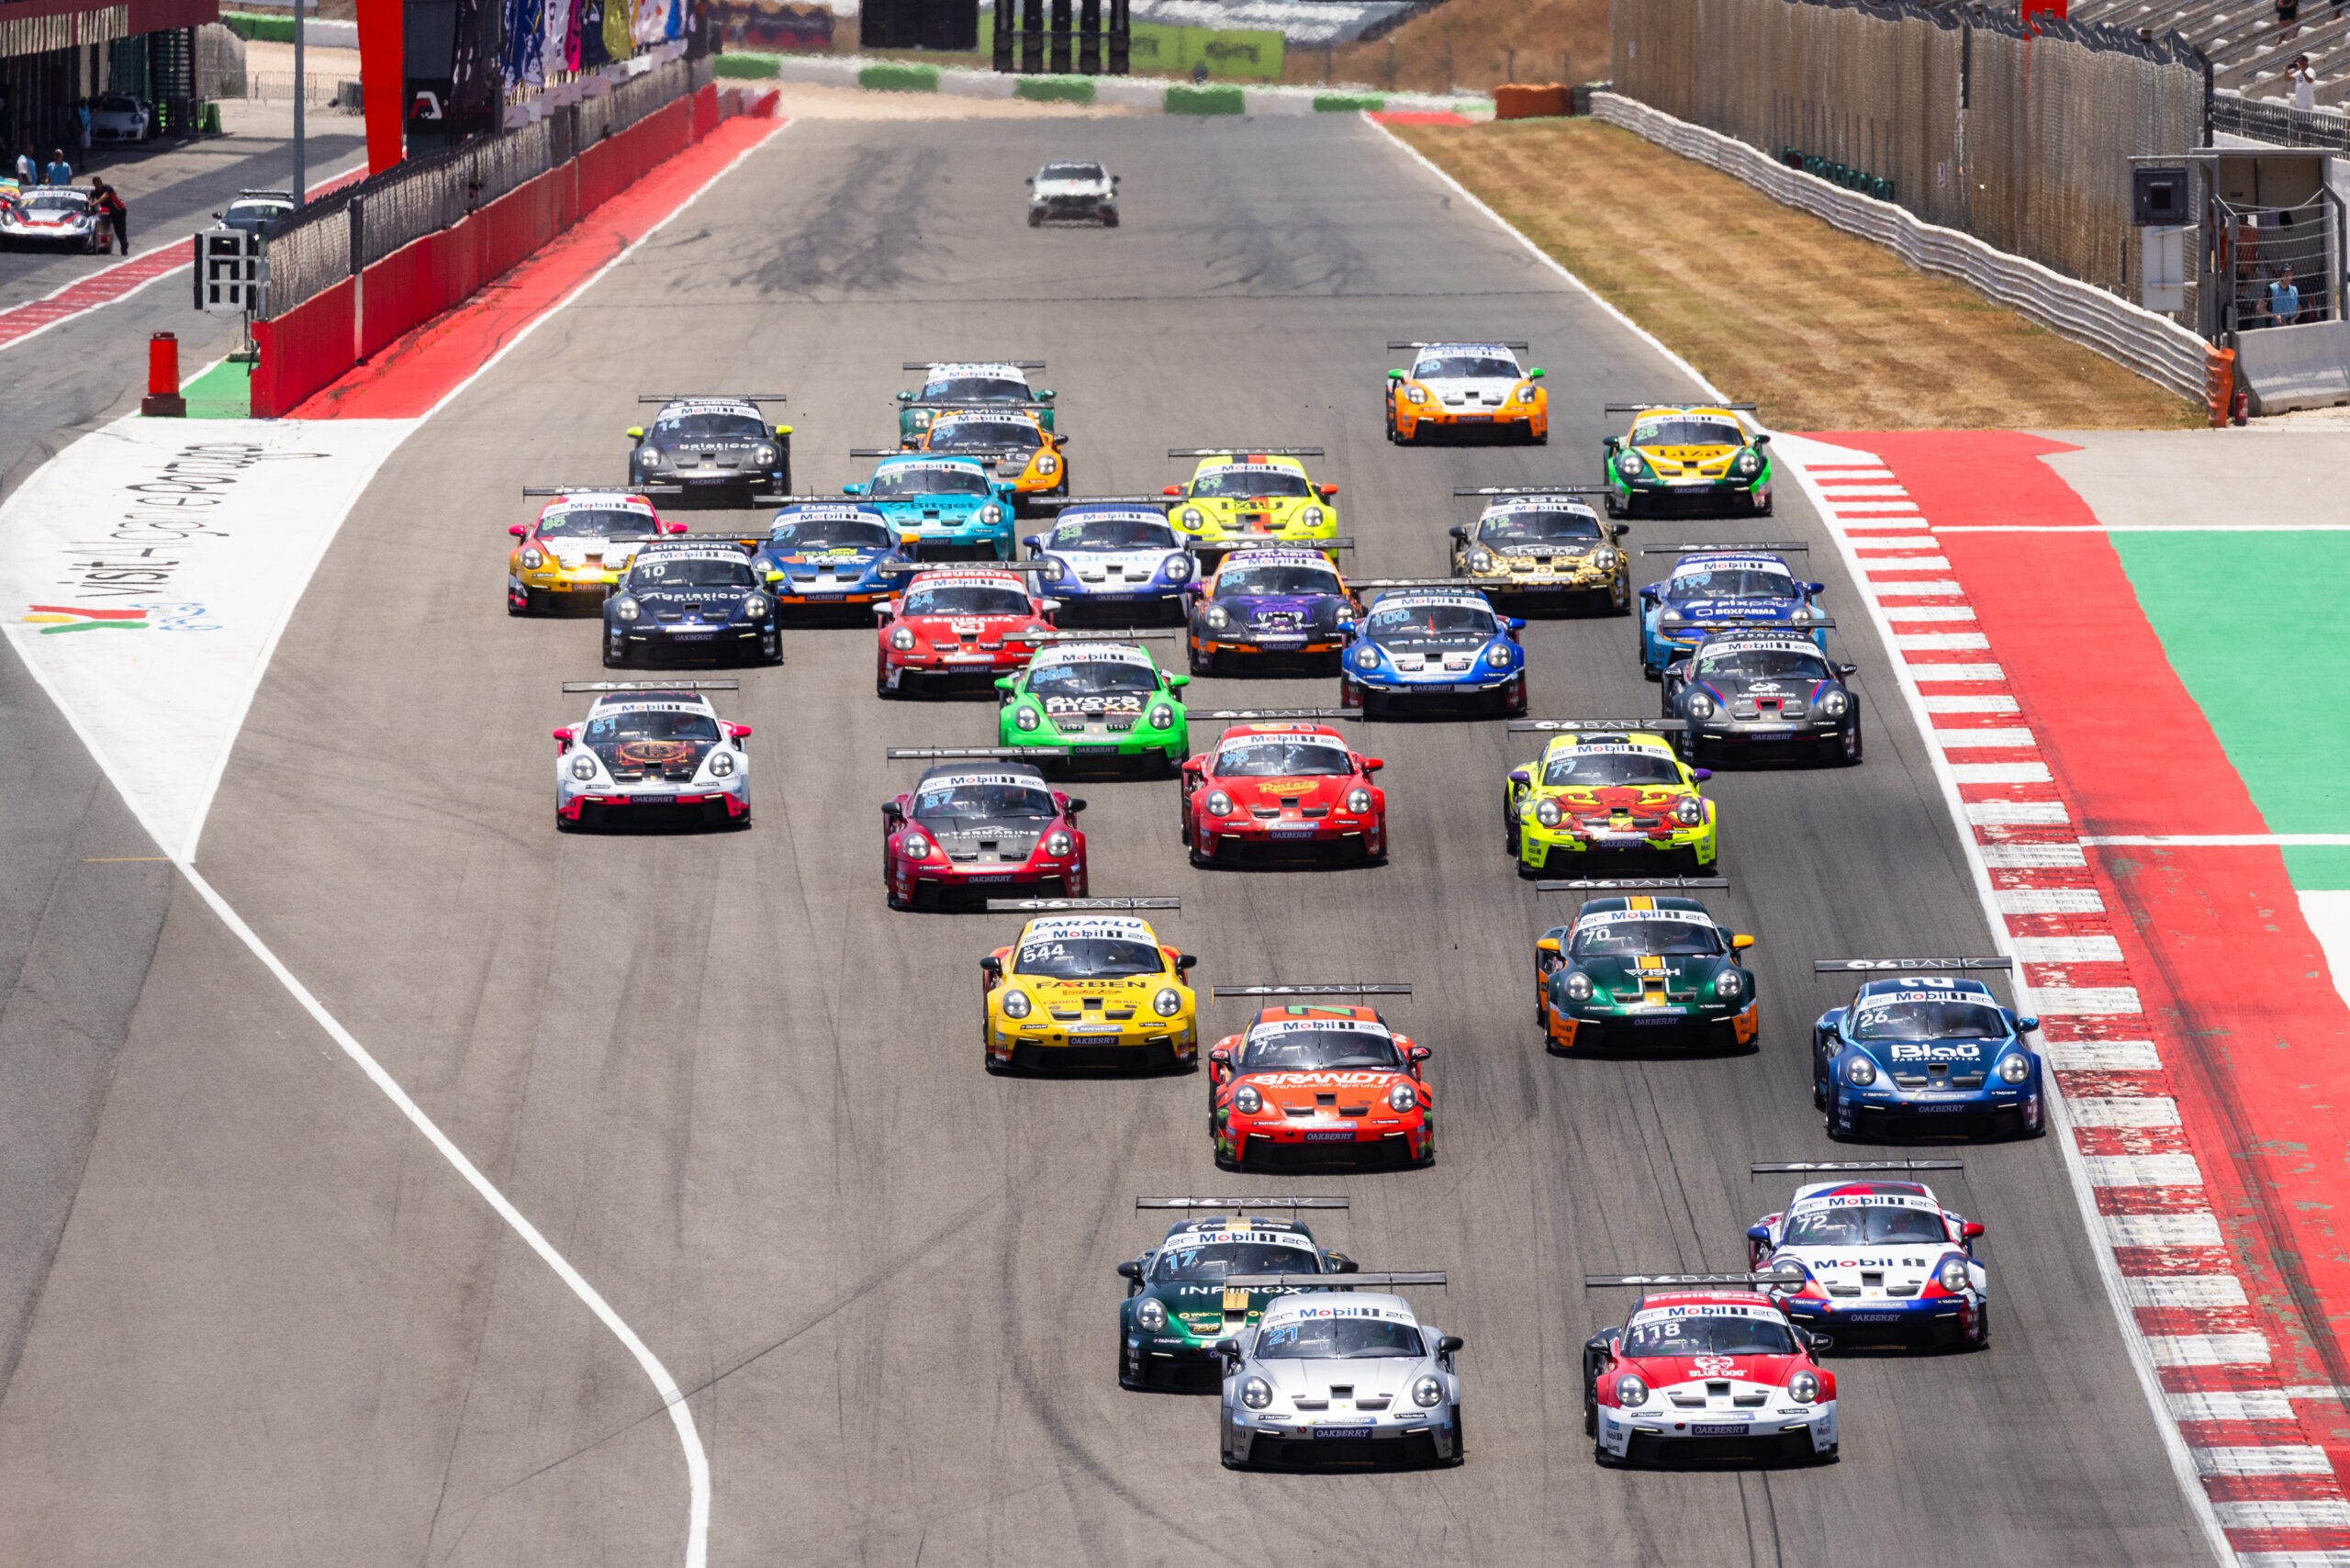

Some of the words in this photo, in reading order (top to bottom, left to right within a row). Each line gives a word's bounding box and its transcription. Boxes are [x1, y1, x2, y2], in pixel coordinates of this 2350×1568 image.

[659, 420, 680, 431] 14
[882, 475, 902, 486] 11
[1198, 477, 1222, 490] 99
[1486, 517, 1509, 530] 12
[773, 526, 796, 541] 27
[642, 566, 666, 578] 10
[922, 571, 1013, 579] SEGURALTA
[1674, 574, 1711, 590] 199
[909, 593, 934, 610] 24
[1372, 610, 1410, 627] 100
[1701, 661, 1715, 673] 2
[1034, 666, 1072, 684] 888
[1550, 761, 1577, 778] 77
[951, 776, 997, 784] Mobil
[924, 792, 953, 808] 87
[1611, 911, 1661, 920] Mobil
[1035, 921, 1142, 930] PARAFLU
[1054, 930, 1103, 938] Mobil
[1583, 929, 1610, 945] 70
[1023, 944, 1065, 963] 544
[1901, 959, 1982, 968] BANK
[1897, 991, 1947, 1001] Mobil
[1860, 1011, 1888, 1028] 26
[1283, 1022, 1335, 1030] Mobil
[1071, 1036, 1115, 1045] OAKBERRY
[1255, 1041, 1269, 1055] 7
[1246, 1072, 1401, 1085] BRANDT
[1830, 1197, 1884, 1205] Mobil
[1797, 1215, 1827, 1233] 72
[1200, 1233, 1255, 1242] Mobil
[1261, 1234, 1274, 1242] 1
[1166, 1251, 1197, 1270] 17
[1815, 1259, 1892, 1269] Mobil
[1905, 1259, 1924, 1267] 1
[1300, 1307, 1357, 1317] Mobil
[1363, 1308, 1378, 1316] 1
[1669, 1306, 1726, 1316] Mobil
[1269, 1327, 1297, 1345] 21
[1633, 1323, 1680, 1343] 118
[1316, 1429, 1369, 1438] OAKBERRY
[1695, 1426, 1746, 1434] OAKBERRY
